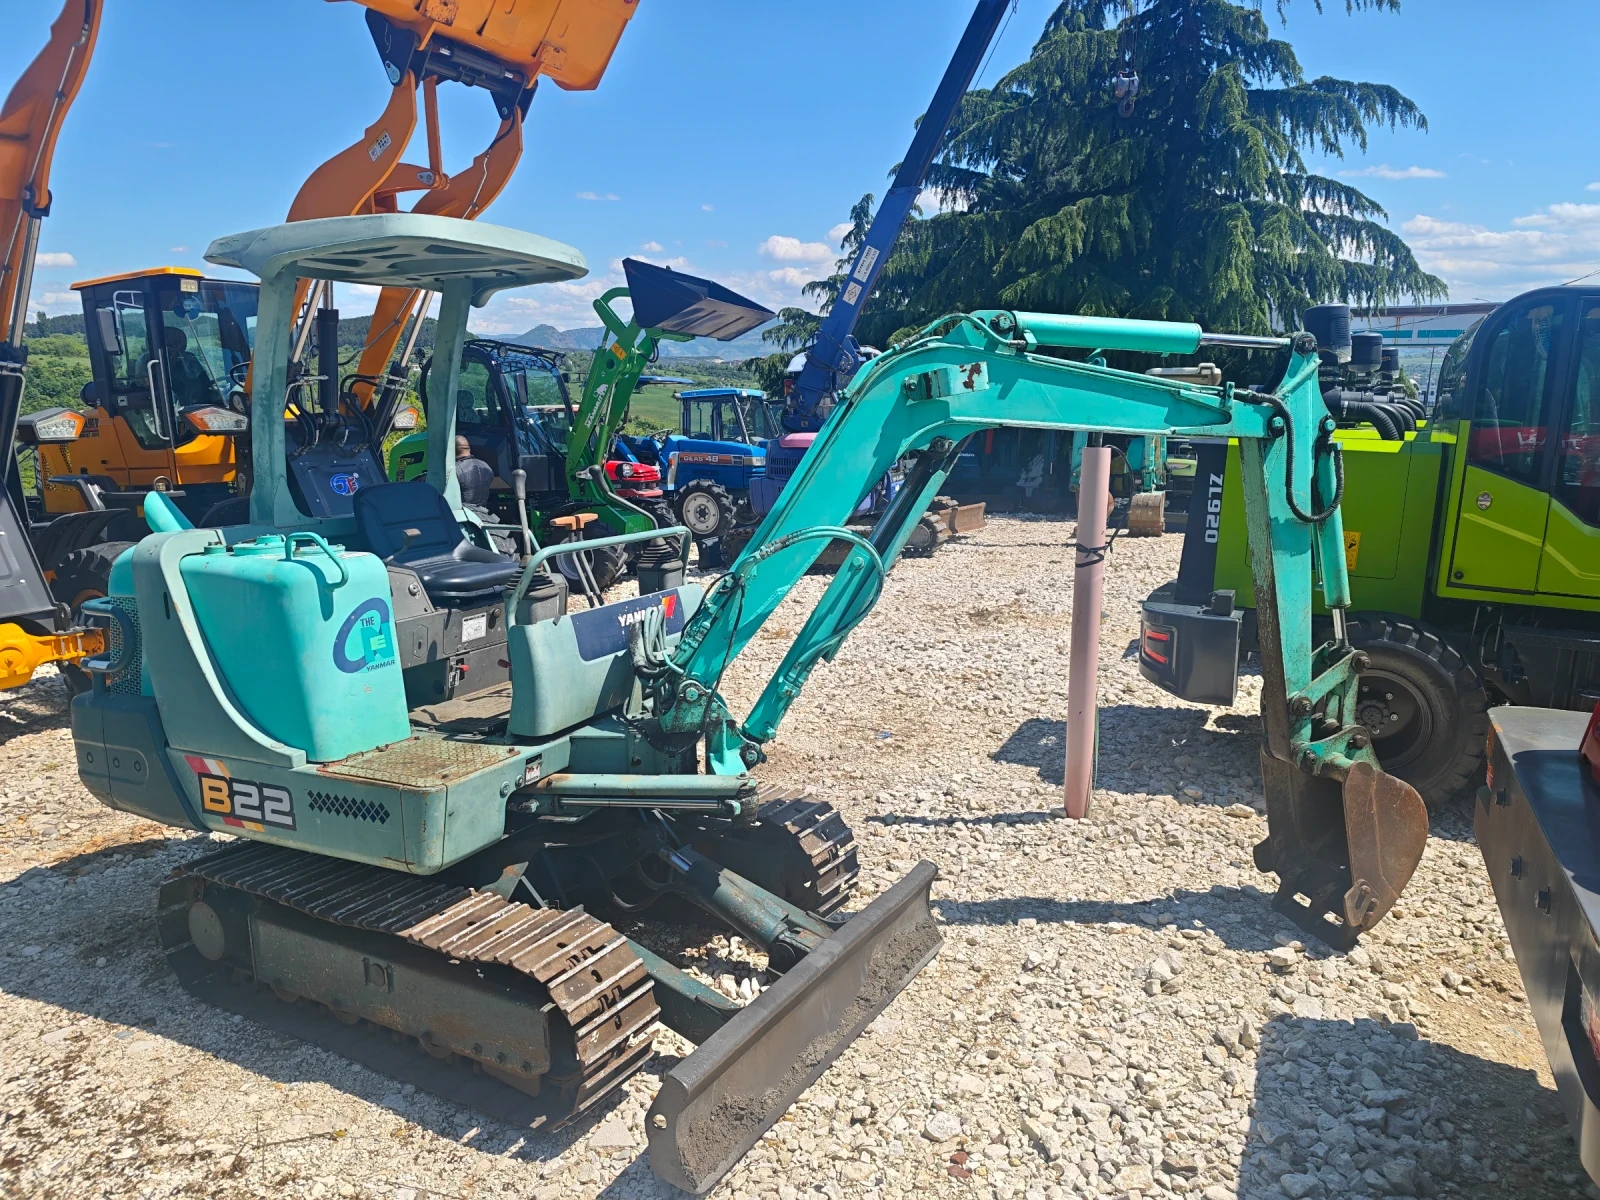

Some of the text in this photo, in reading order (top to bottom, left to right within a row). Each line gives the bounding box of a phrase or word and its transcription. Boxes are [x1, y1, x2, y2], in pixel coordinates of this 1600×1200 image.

[705, 455, 719, 463] 48
[1205, 473, 1224, 544] ZL920
[361, 616, 375, 627] THE
[366, 660, 395, 671] YANMAR
[200, 774, 295, 828] B22
